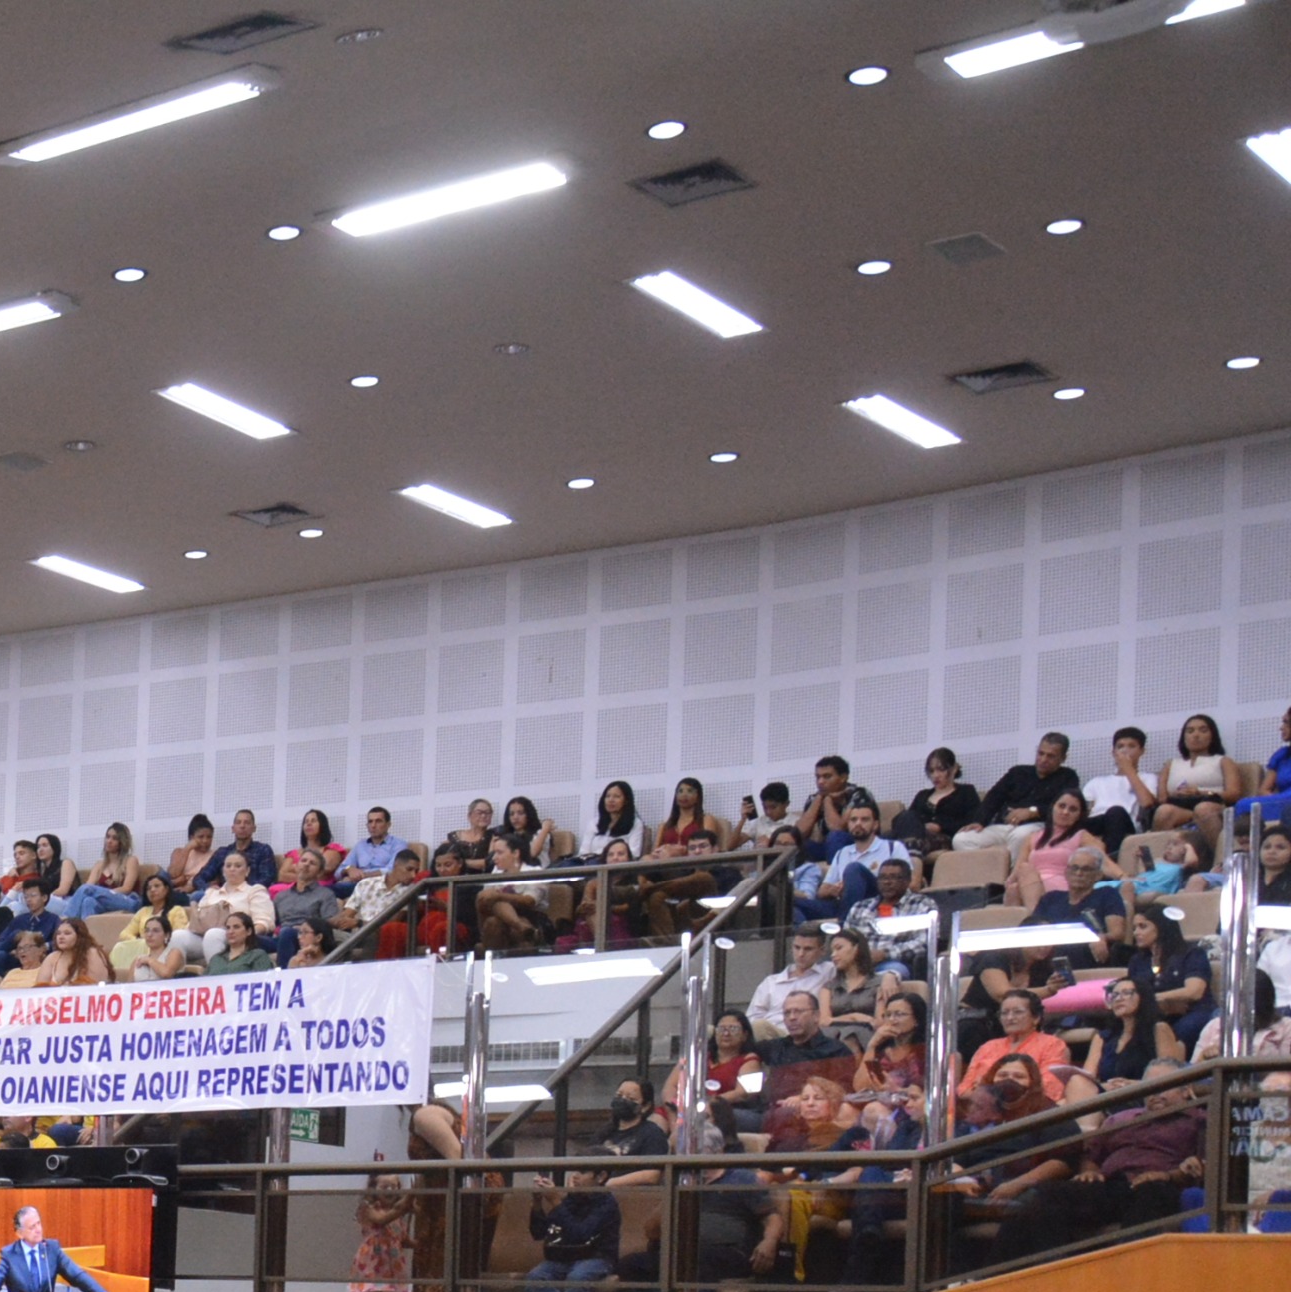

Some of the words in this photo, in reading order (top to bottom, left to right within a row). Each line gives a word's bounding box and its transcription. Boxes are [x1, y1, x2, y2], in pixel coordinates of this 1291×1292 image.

[11, 994, 123, 1024] ANSELMO
[130, 986, 226, 1020] PEREIRA
[235, 980, 281, 1011] TEM
[288, 979, 305, 1008] A
[39, 1034, 112, 1064] JUSTA
[121, 1027, 267, 1061] HOMENAGEM
[274, 1023, 292, 1051] A
[302, 1017, 386, 1050] TODOS
[133, 1071, 189, 1101] AQUI
[197, 1061, 409, 1096] REPRESENTANDO
[290, 1110, 309, 1128] AÍDA
